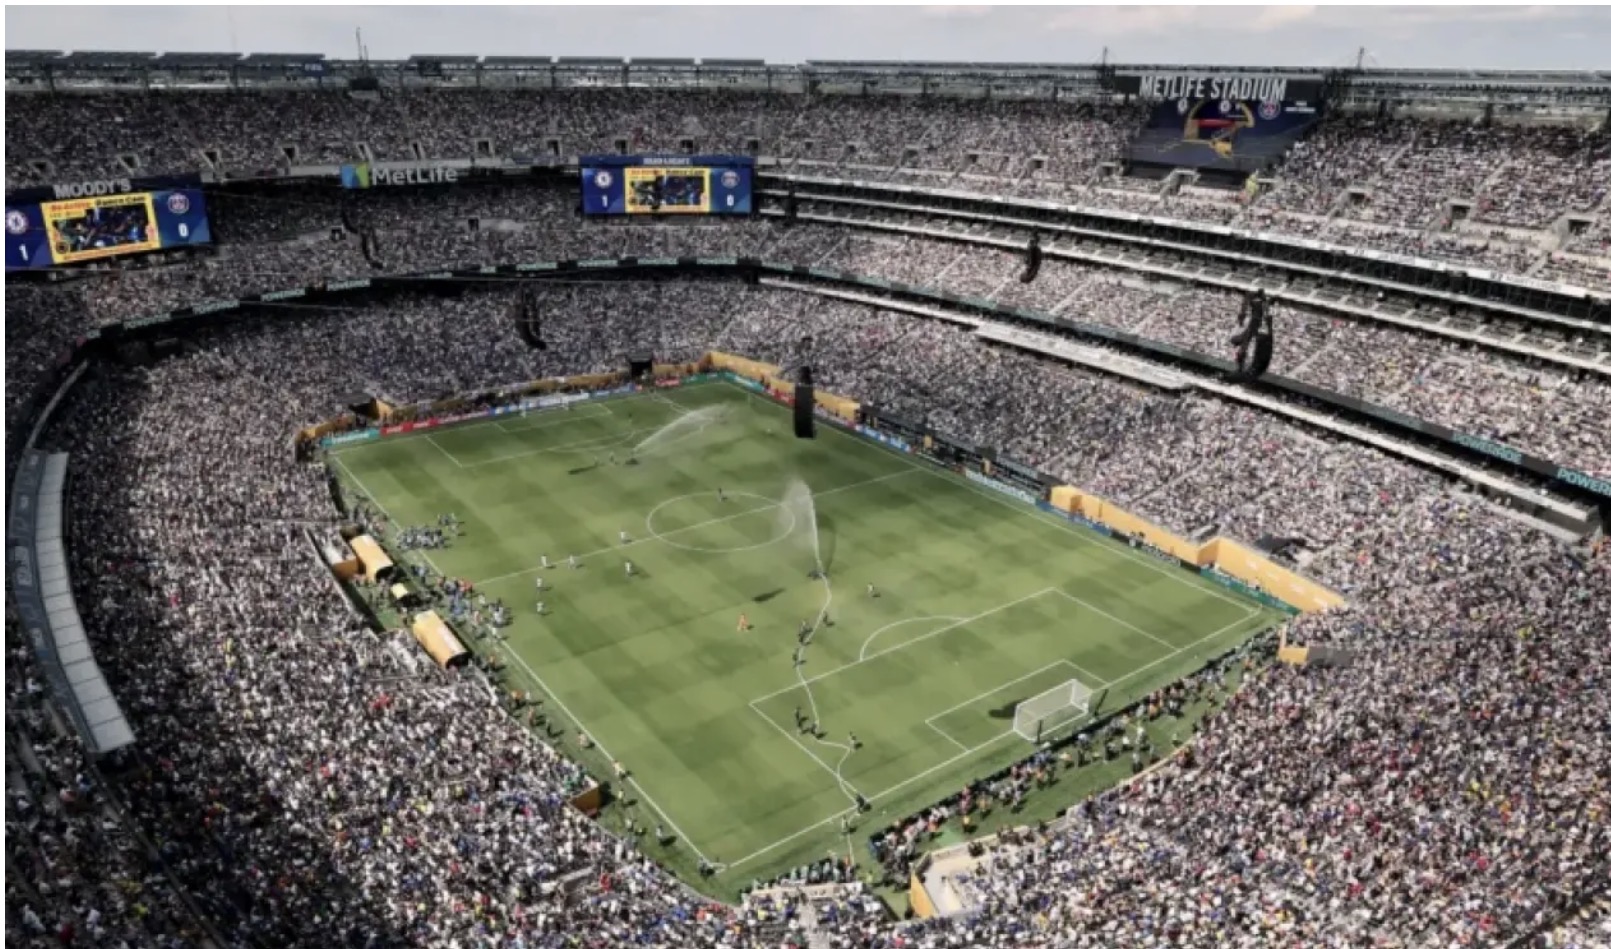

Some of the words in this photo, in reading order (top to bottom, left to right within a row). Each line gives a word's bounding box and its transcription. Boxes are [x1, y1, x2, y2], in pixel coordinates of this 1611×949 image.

[1139, 76, 1206, 99] METLIFE
[1210, 77, 1287, 101] STADIUM
[371, 165, 458, 186] MetLife
[53, 179, 132, 199] MOODY'S
[602, 194, 608, 207] 1
[726, 194, 735, 207] 0
[178, 222, 189, 237] 0
[18, 243, 28, 261] 1
